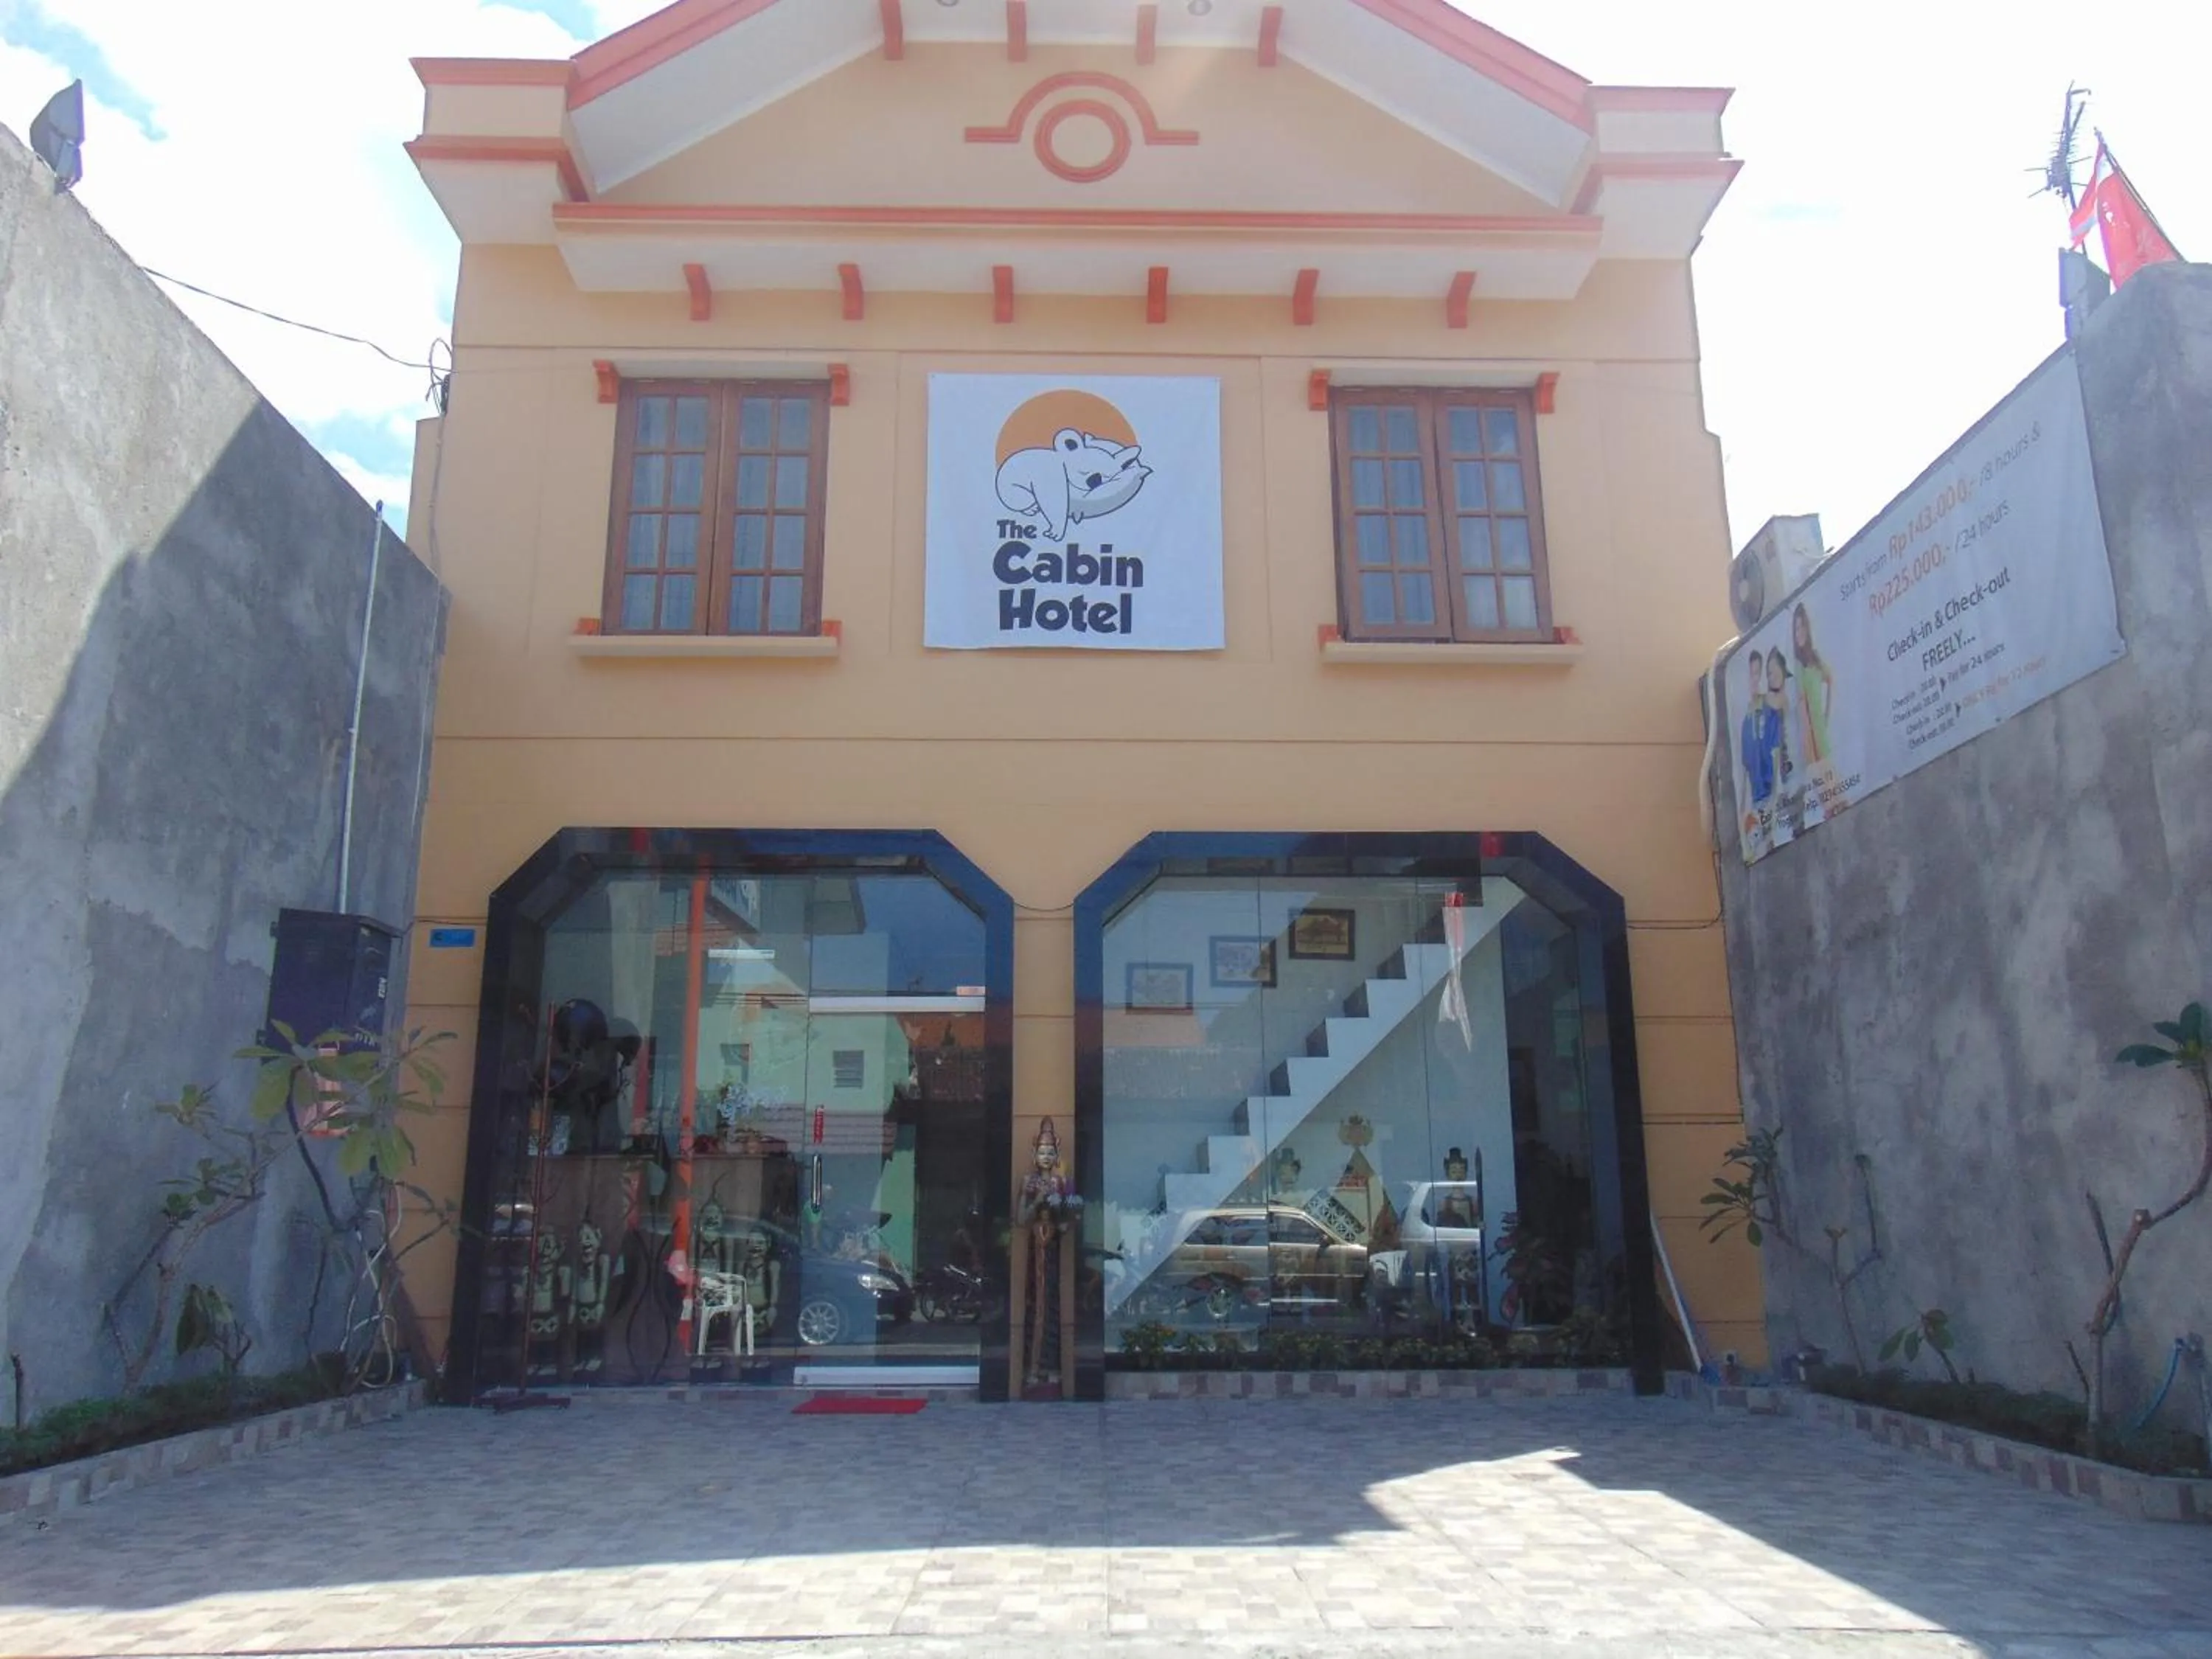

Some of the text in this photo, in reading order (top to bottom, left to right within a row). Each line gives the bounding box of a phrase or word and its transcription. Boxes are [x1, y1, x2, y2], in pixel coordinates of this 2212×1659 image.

[1995, 434, 2030, 471] hours
[997, 519, 1037, 539] The
[1978, 499, 2011, 538] hours
[992, 540, 1144, 588] Cabin
[999, 588, 1133, 633] Hotel
[1888, 566, 2011, 661] Check-in & Check-out
[1922, 629, 1976, 672] FREELY...
